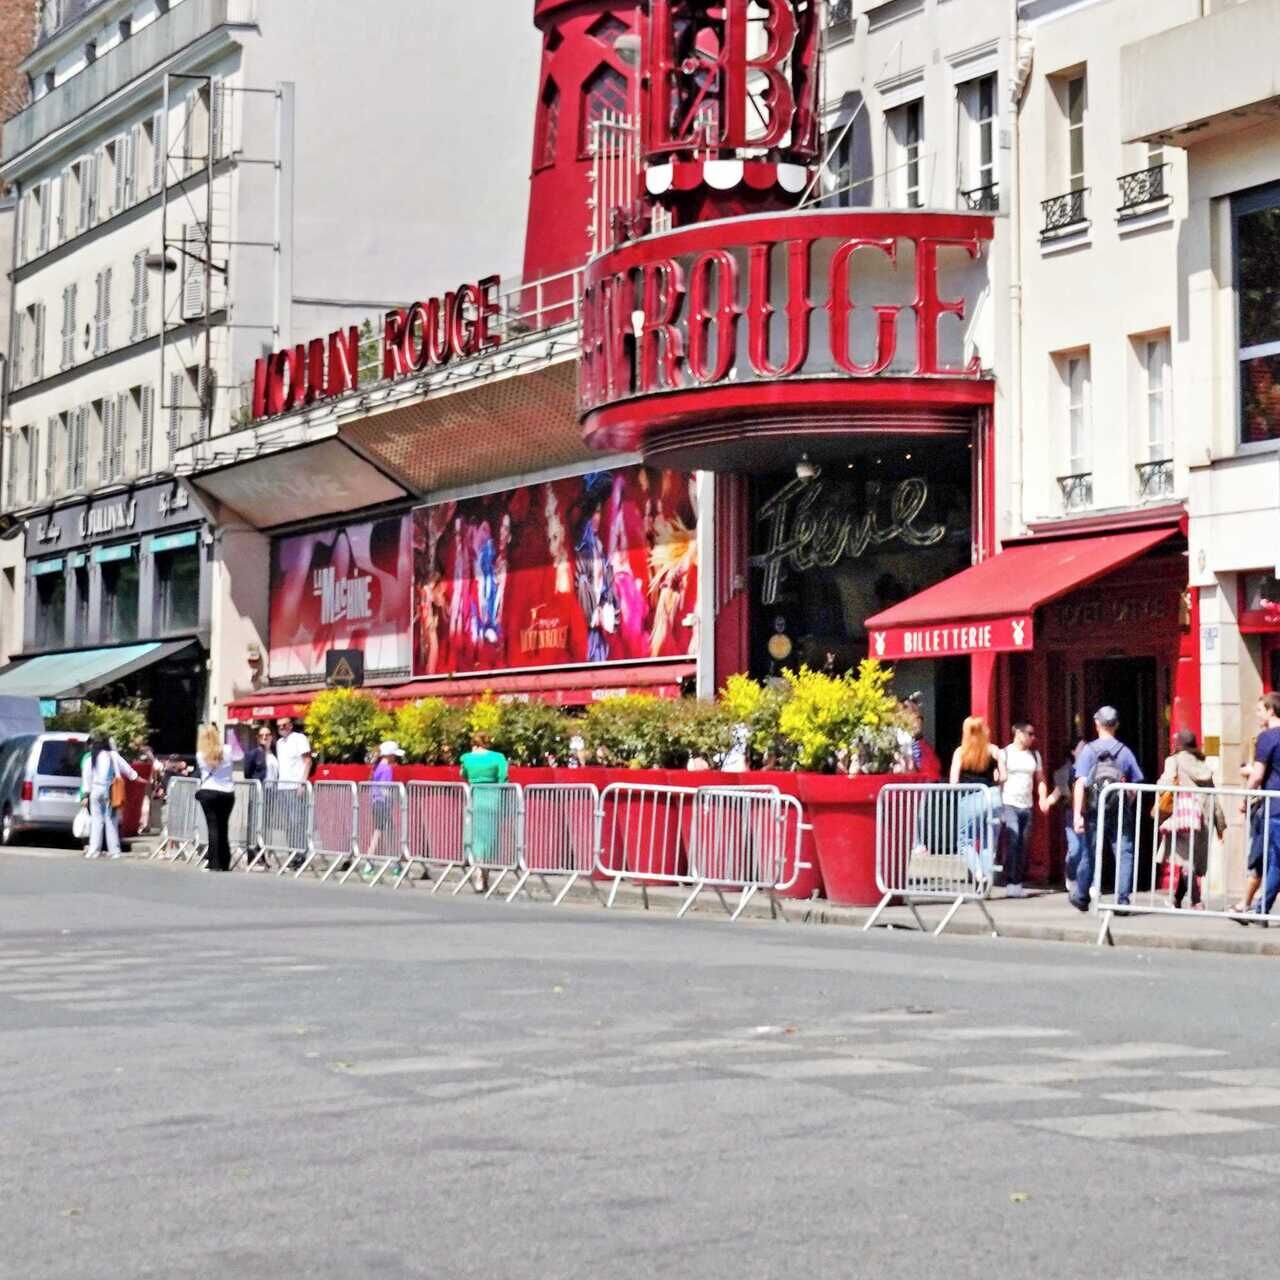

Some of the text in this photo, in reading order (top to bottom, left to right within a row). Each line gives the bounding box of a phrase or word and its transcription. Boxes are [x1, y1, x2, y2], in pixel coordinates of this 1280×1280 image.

[382, 274, 501, 381] ROUGE
[631, 236, 982, 393] ROUGE
[903, 624, 992, 654] BILLETTERIE
